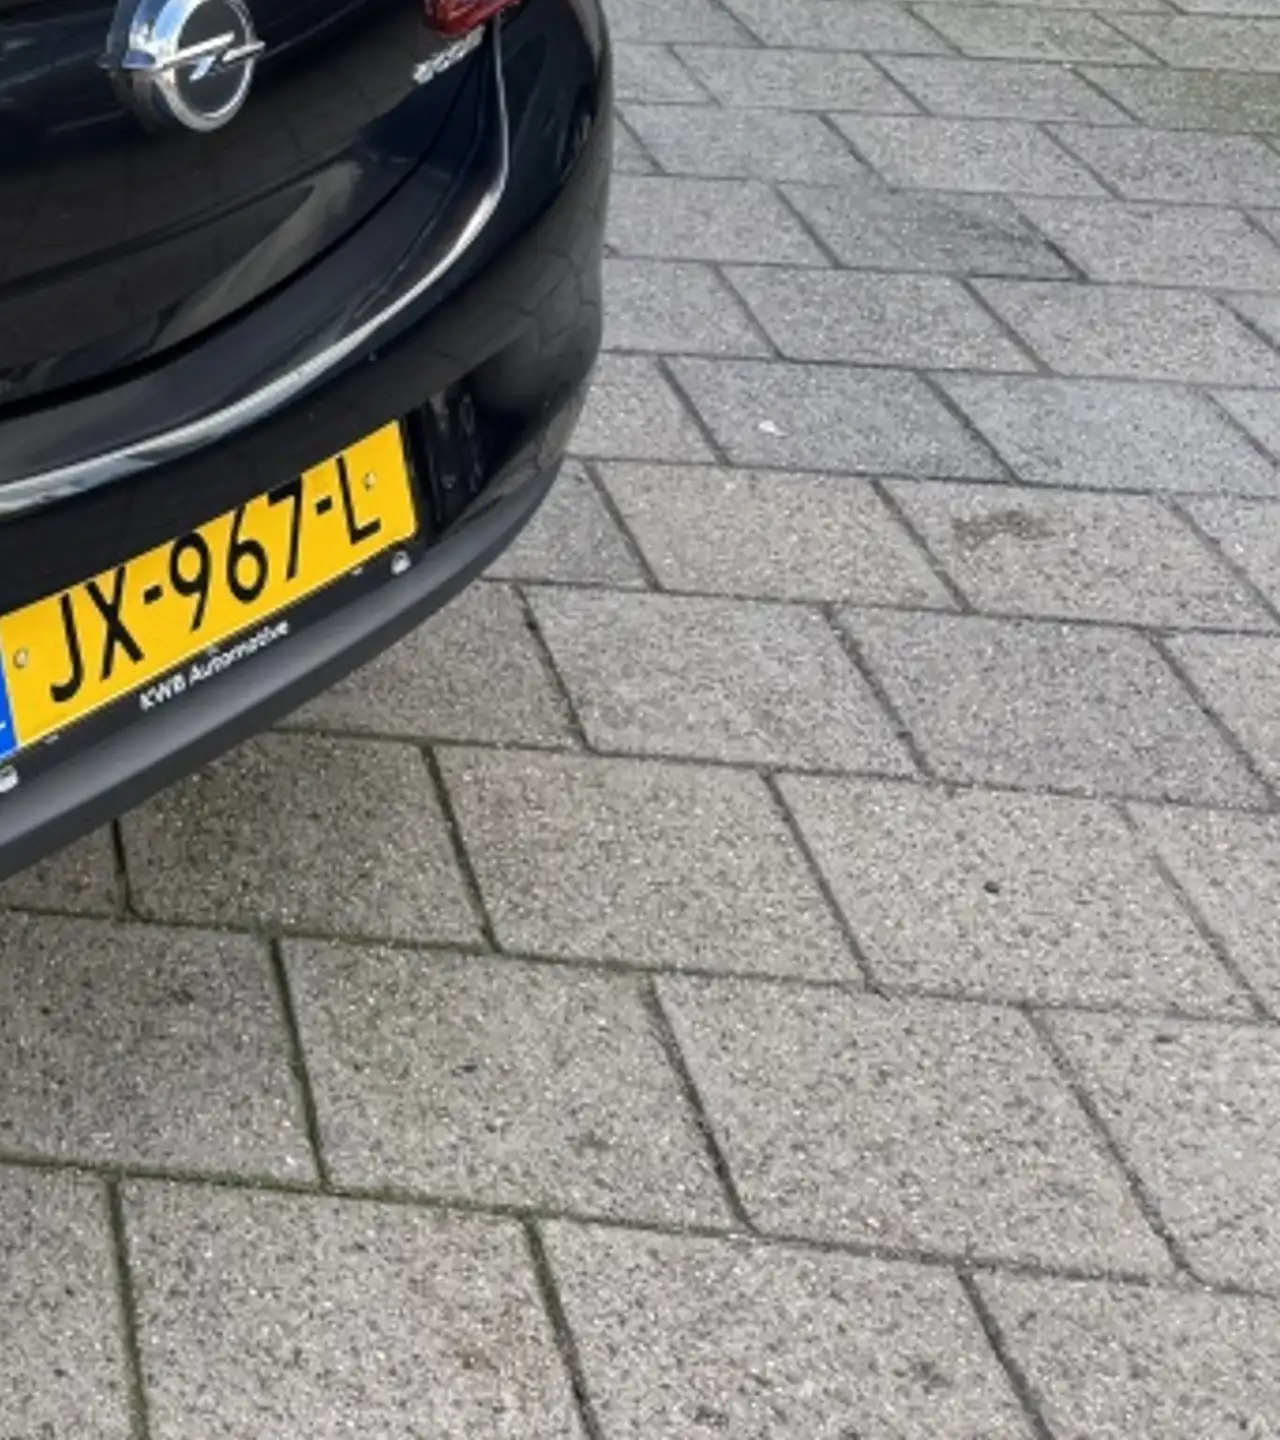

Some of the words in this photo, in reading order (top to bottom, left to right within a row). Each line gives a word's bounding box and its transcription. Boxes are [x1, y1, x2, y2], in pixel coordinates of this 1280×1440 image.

[50, 453, 382, 703] JX-967-L
[139, 671, 187, 711] KWB
[189, 620, 289, 687] Automotive
